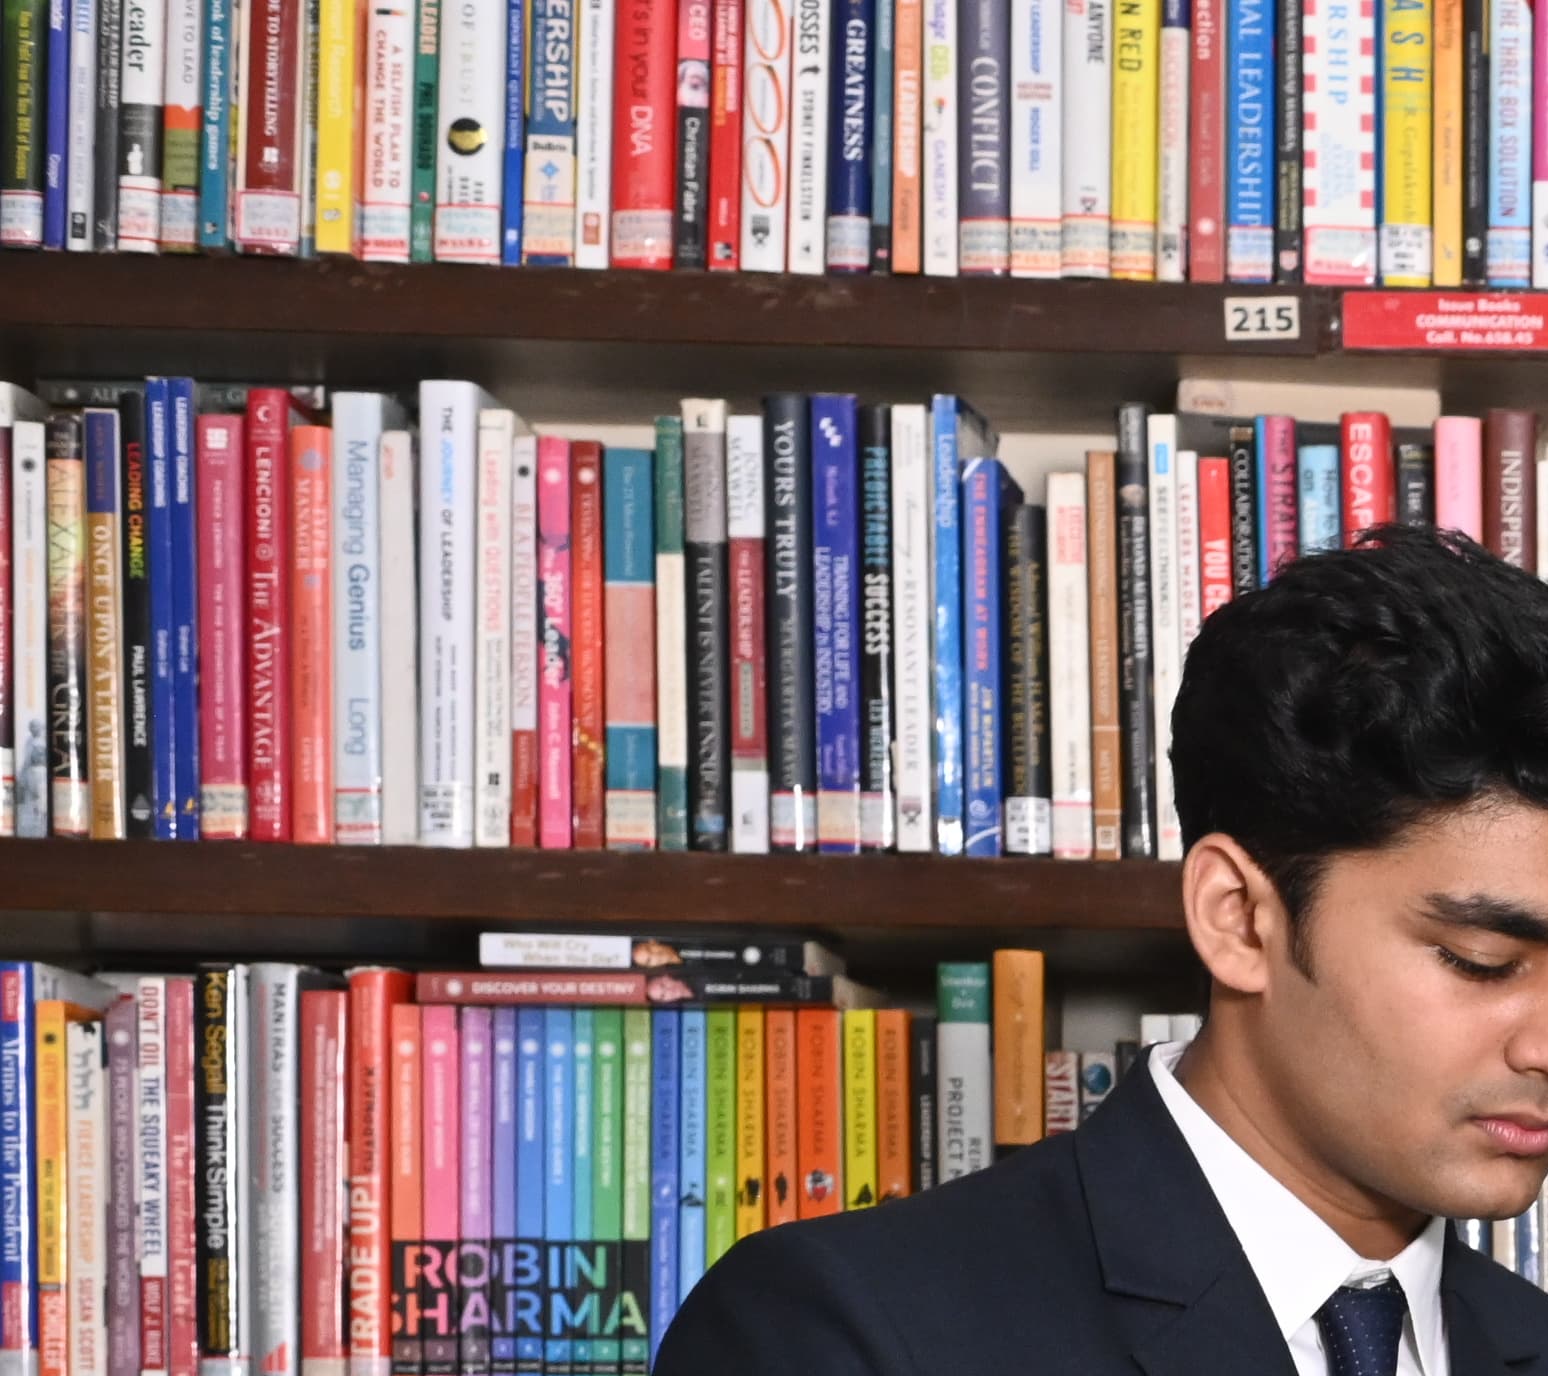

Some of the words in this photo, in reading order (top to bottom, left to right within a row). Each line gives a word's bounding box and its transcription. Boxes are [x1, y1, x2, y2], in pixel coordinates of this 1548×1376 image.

[207, 27, 225, 42] of
[207, 45, 225, 120] leadership
[800, 89, 814, 136] SYDNEY
[844, 18, 866, 160] GREATNESS
[207, 125, 225, 170] games
[682, 116, 701, 176] Christian
[970, 56, 1001, 197] CONFLICT
[682, 181, 701, 222] Fabre
[800, 142, 814, 221] FINKELSTEIN
[1233, 307, 1293, 331] 215
[1416, 316, 1543, 328] COMMUNICATION
[129, 443, 144, 509] LEADING
[256, 447, 271, 537] LENCIONI
[775, 420, 796, 506] YOURS
[344, 441, 369, 556] Managing
[866, 446, 890, 567] PREDICTABLE
[129, 514, 144, 578] CHANGE
[775, 519, 796, 598] TRULY
[253, 570, 276, 608] THE
[349, 564, 369, 650] Genius
[866, 574, 890, 654] SUCCESS
[133, 645, 146, 675] PAUL
[133, 680, 146, 746] LAWRENCE
[252, 618, 280, 770] ADVANTAGE
[346, 698, 370, 755] Long
[142, 986, 160, 1034] DON'T
[472, 982, 537, 995] DISCOVER
[540, 982, 580, 995] YOUR
[583, 982, 636, 995] DESTINY
[142, 1040, 160, 1068] OIL
[714, 1027, 728, 1080] ROBIN
[142, 1077, 160, 1105] THE
[142, 1110, 160, 1191] SQUEAKY
[714, 1089, 728, 1158] SHARMA
[142, 1200, 160, 1257] WHEEL
[404, 1245, 606, 1289] ROBIN
